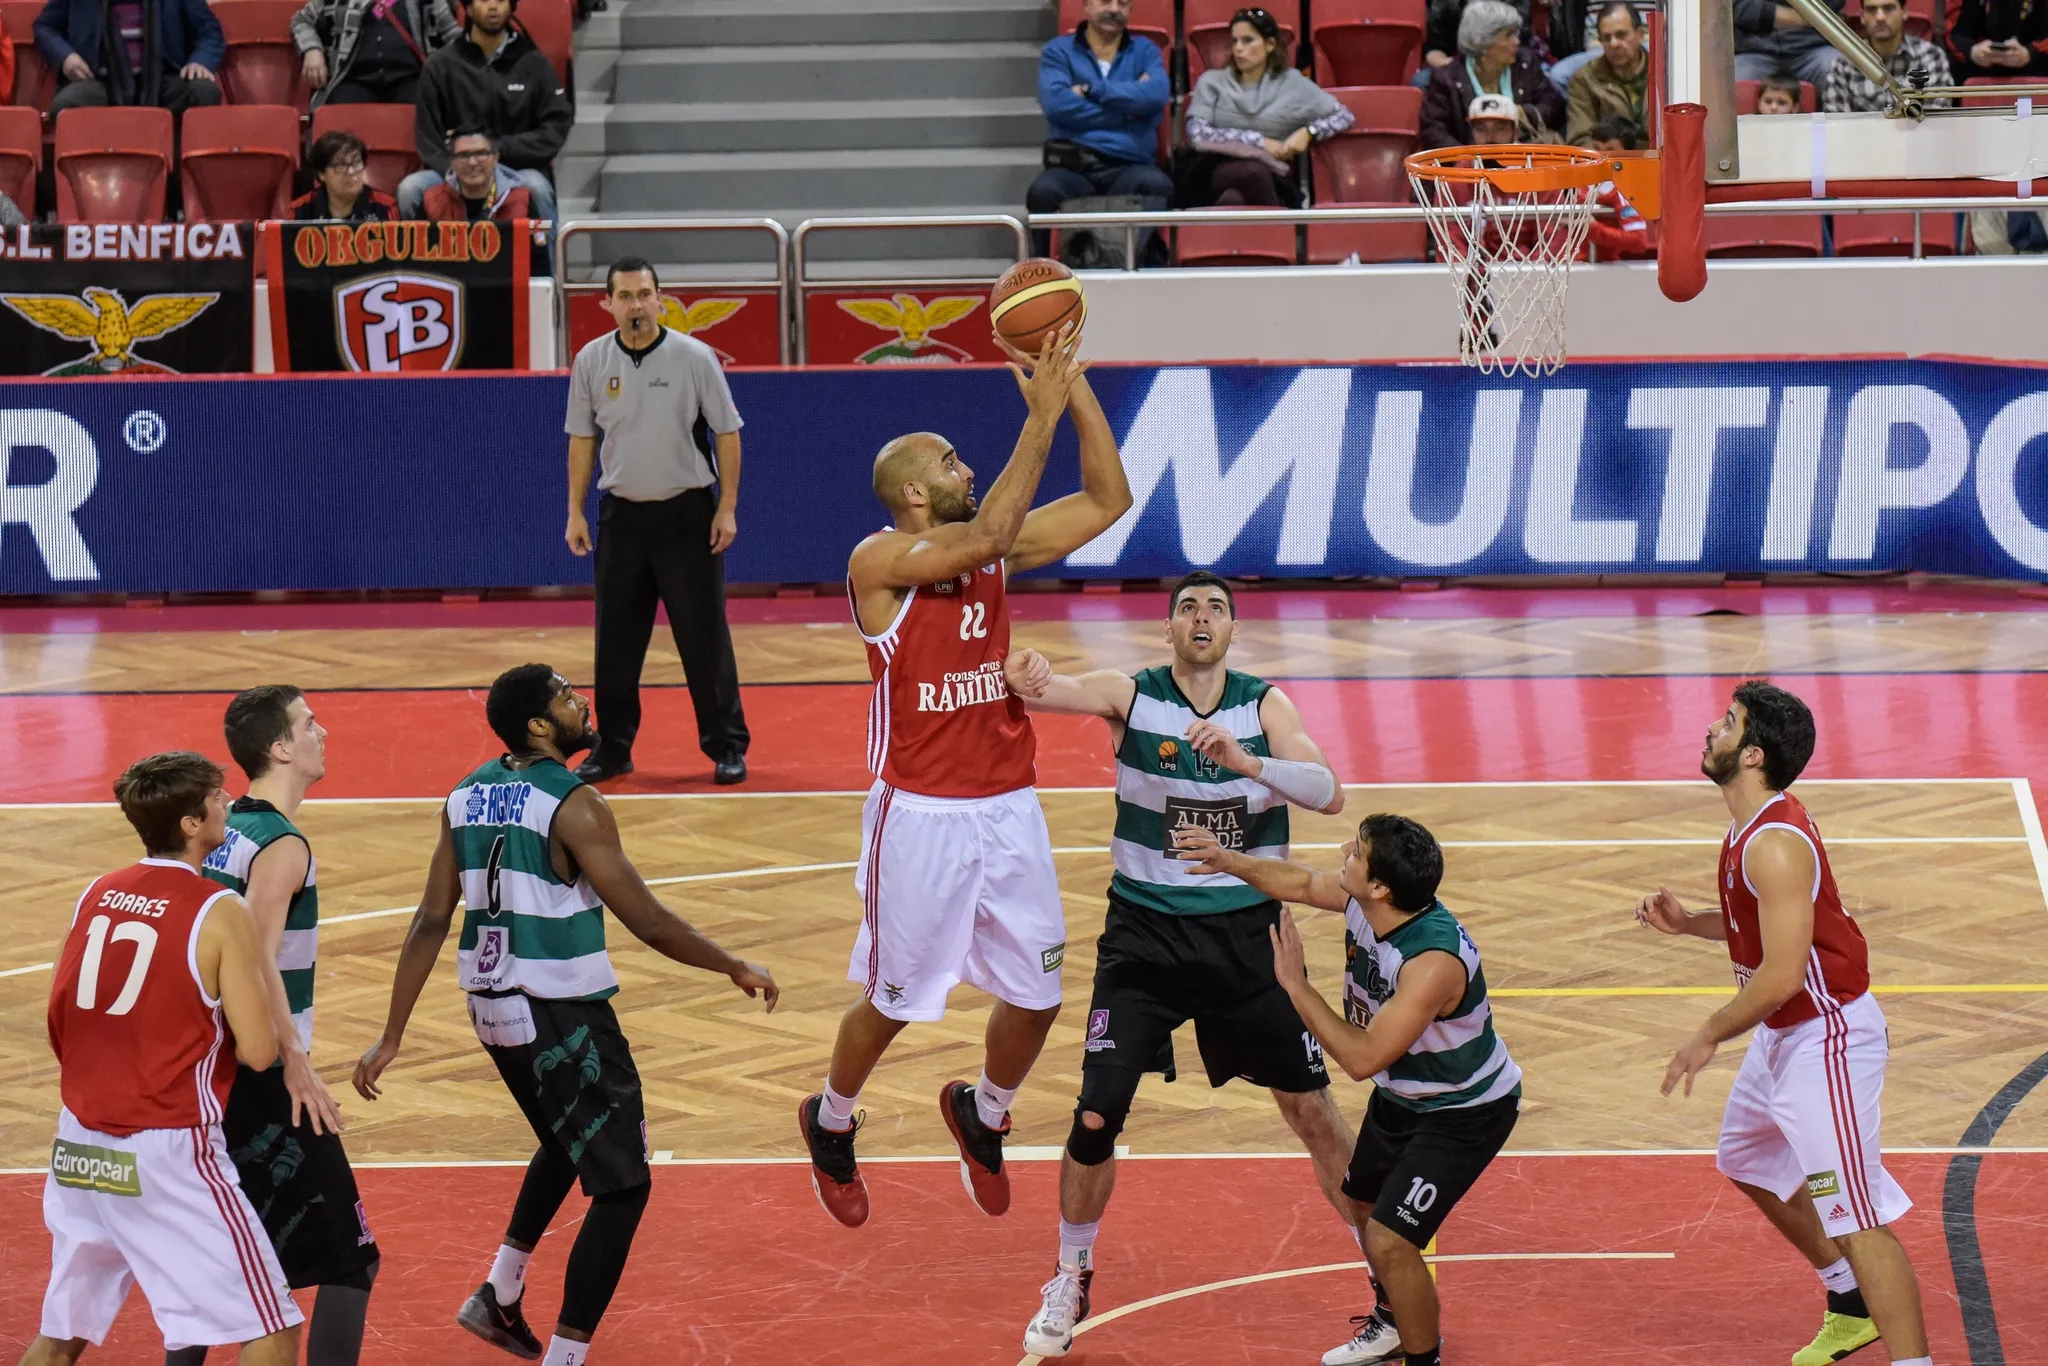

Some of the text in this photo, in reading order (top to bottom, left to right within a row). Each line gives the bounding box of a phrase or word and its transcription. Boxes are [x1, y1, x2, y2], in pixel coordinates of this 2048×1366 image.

[0, 223, 243, 259] .L. BENFICA
[295, 221, 501, 268] ORGULHO
[960, 602, 987, 641] 22
[917, 671, 1009, 712] RAMIRE
[1160, 761, 1176, 771] LPB
[1174, 810, 1239, 830] ALMA
[1168, 829, 1244, 849] VDE
[98, 889, 170, 918] SOARES
[76, 915, 159, 1016] 17
[1301, 1031, 1322, 1062] 14
[53, 1145, 133, 1184] Europcar
[1403, 1176, 1437, 1212] 10
[1828, 1211, 1850, 1221] adidas
